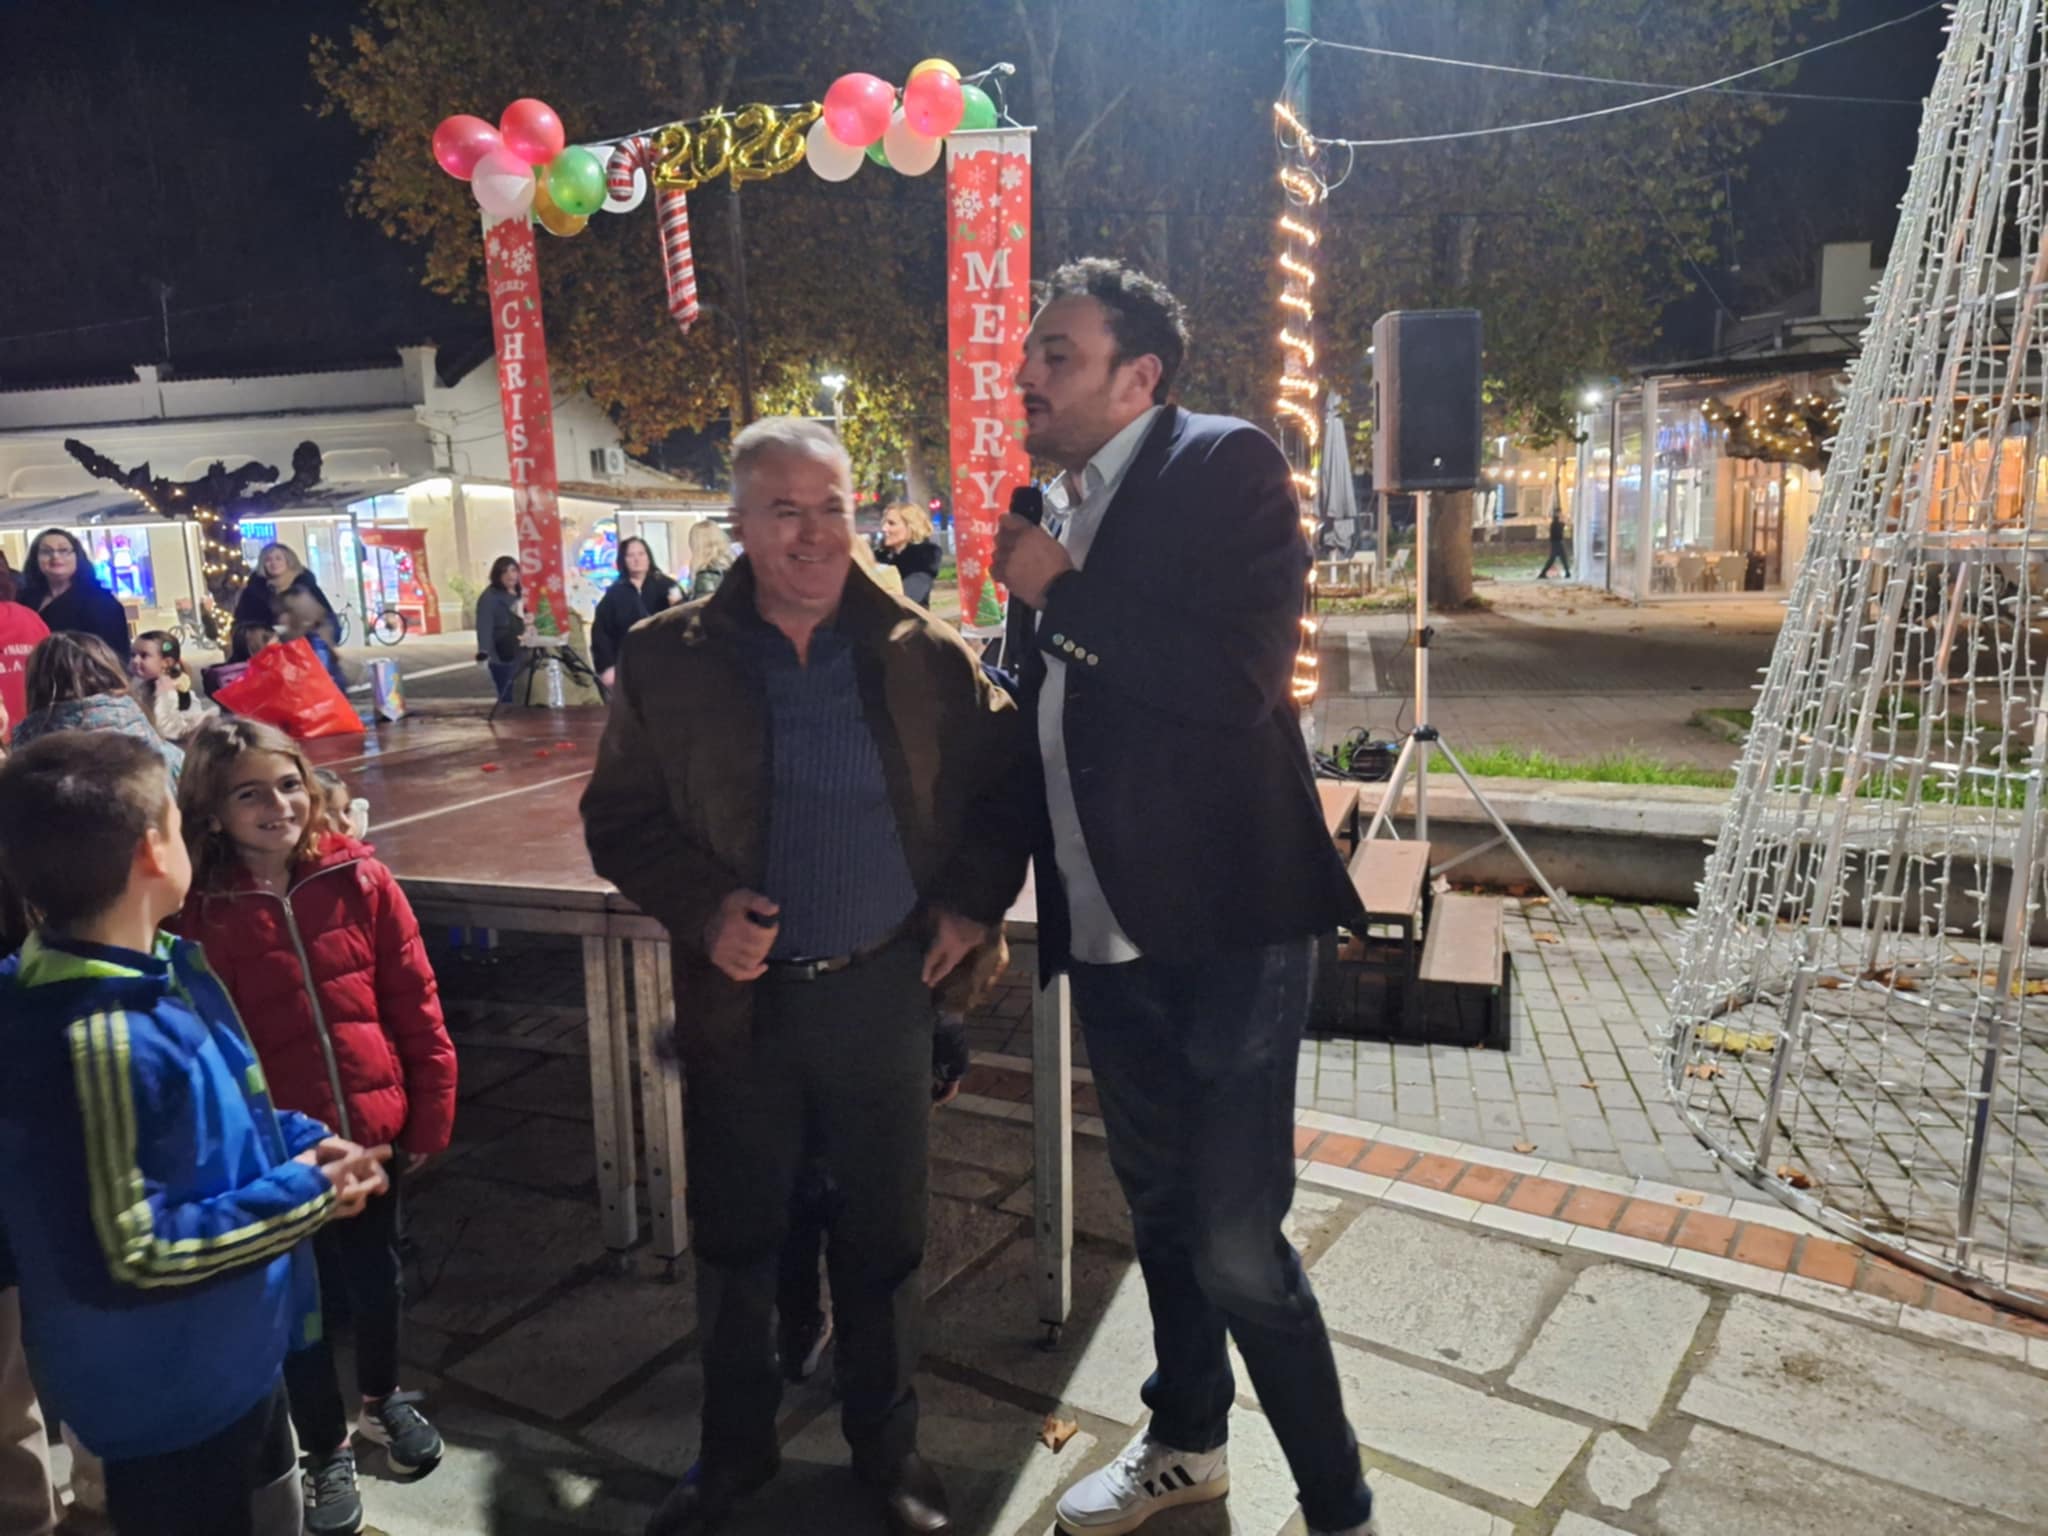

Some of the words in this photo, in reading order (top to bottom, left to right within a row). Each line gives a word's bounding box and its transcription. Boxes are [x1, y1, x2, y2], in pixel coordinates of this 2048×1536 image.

[651, 101, 823, 190] 2026
[501, 300, 543, 575] CHRISTMAS
[962, 248, 1014, 509] MERRY
